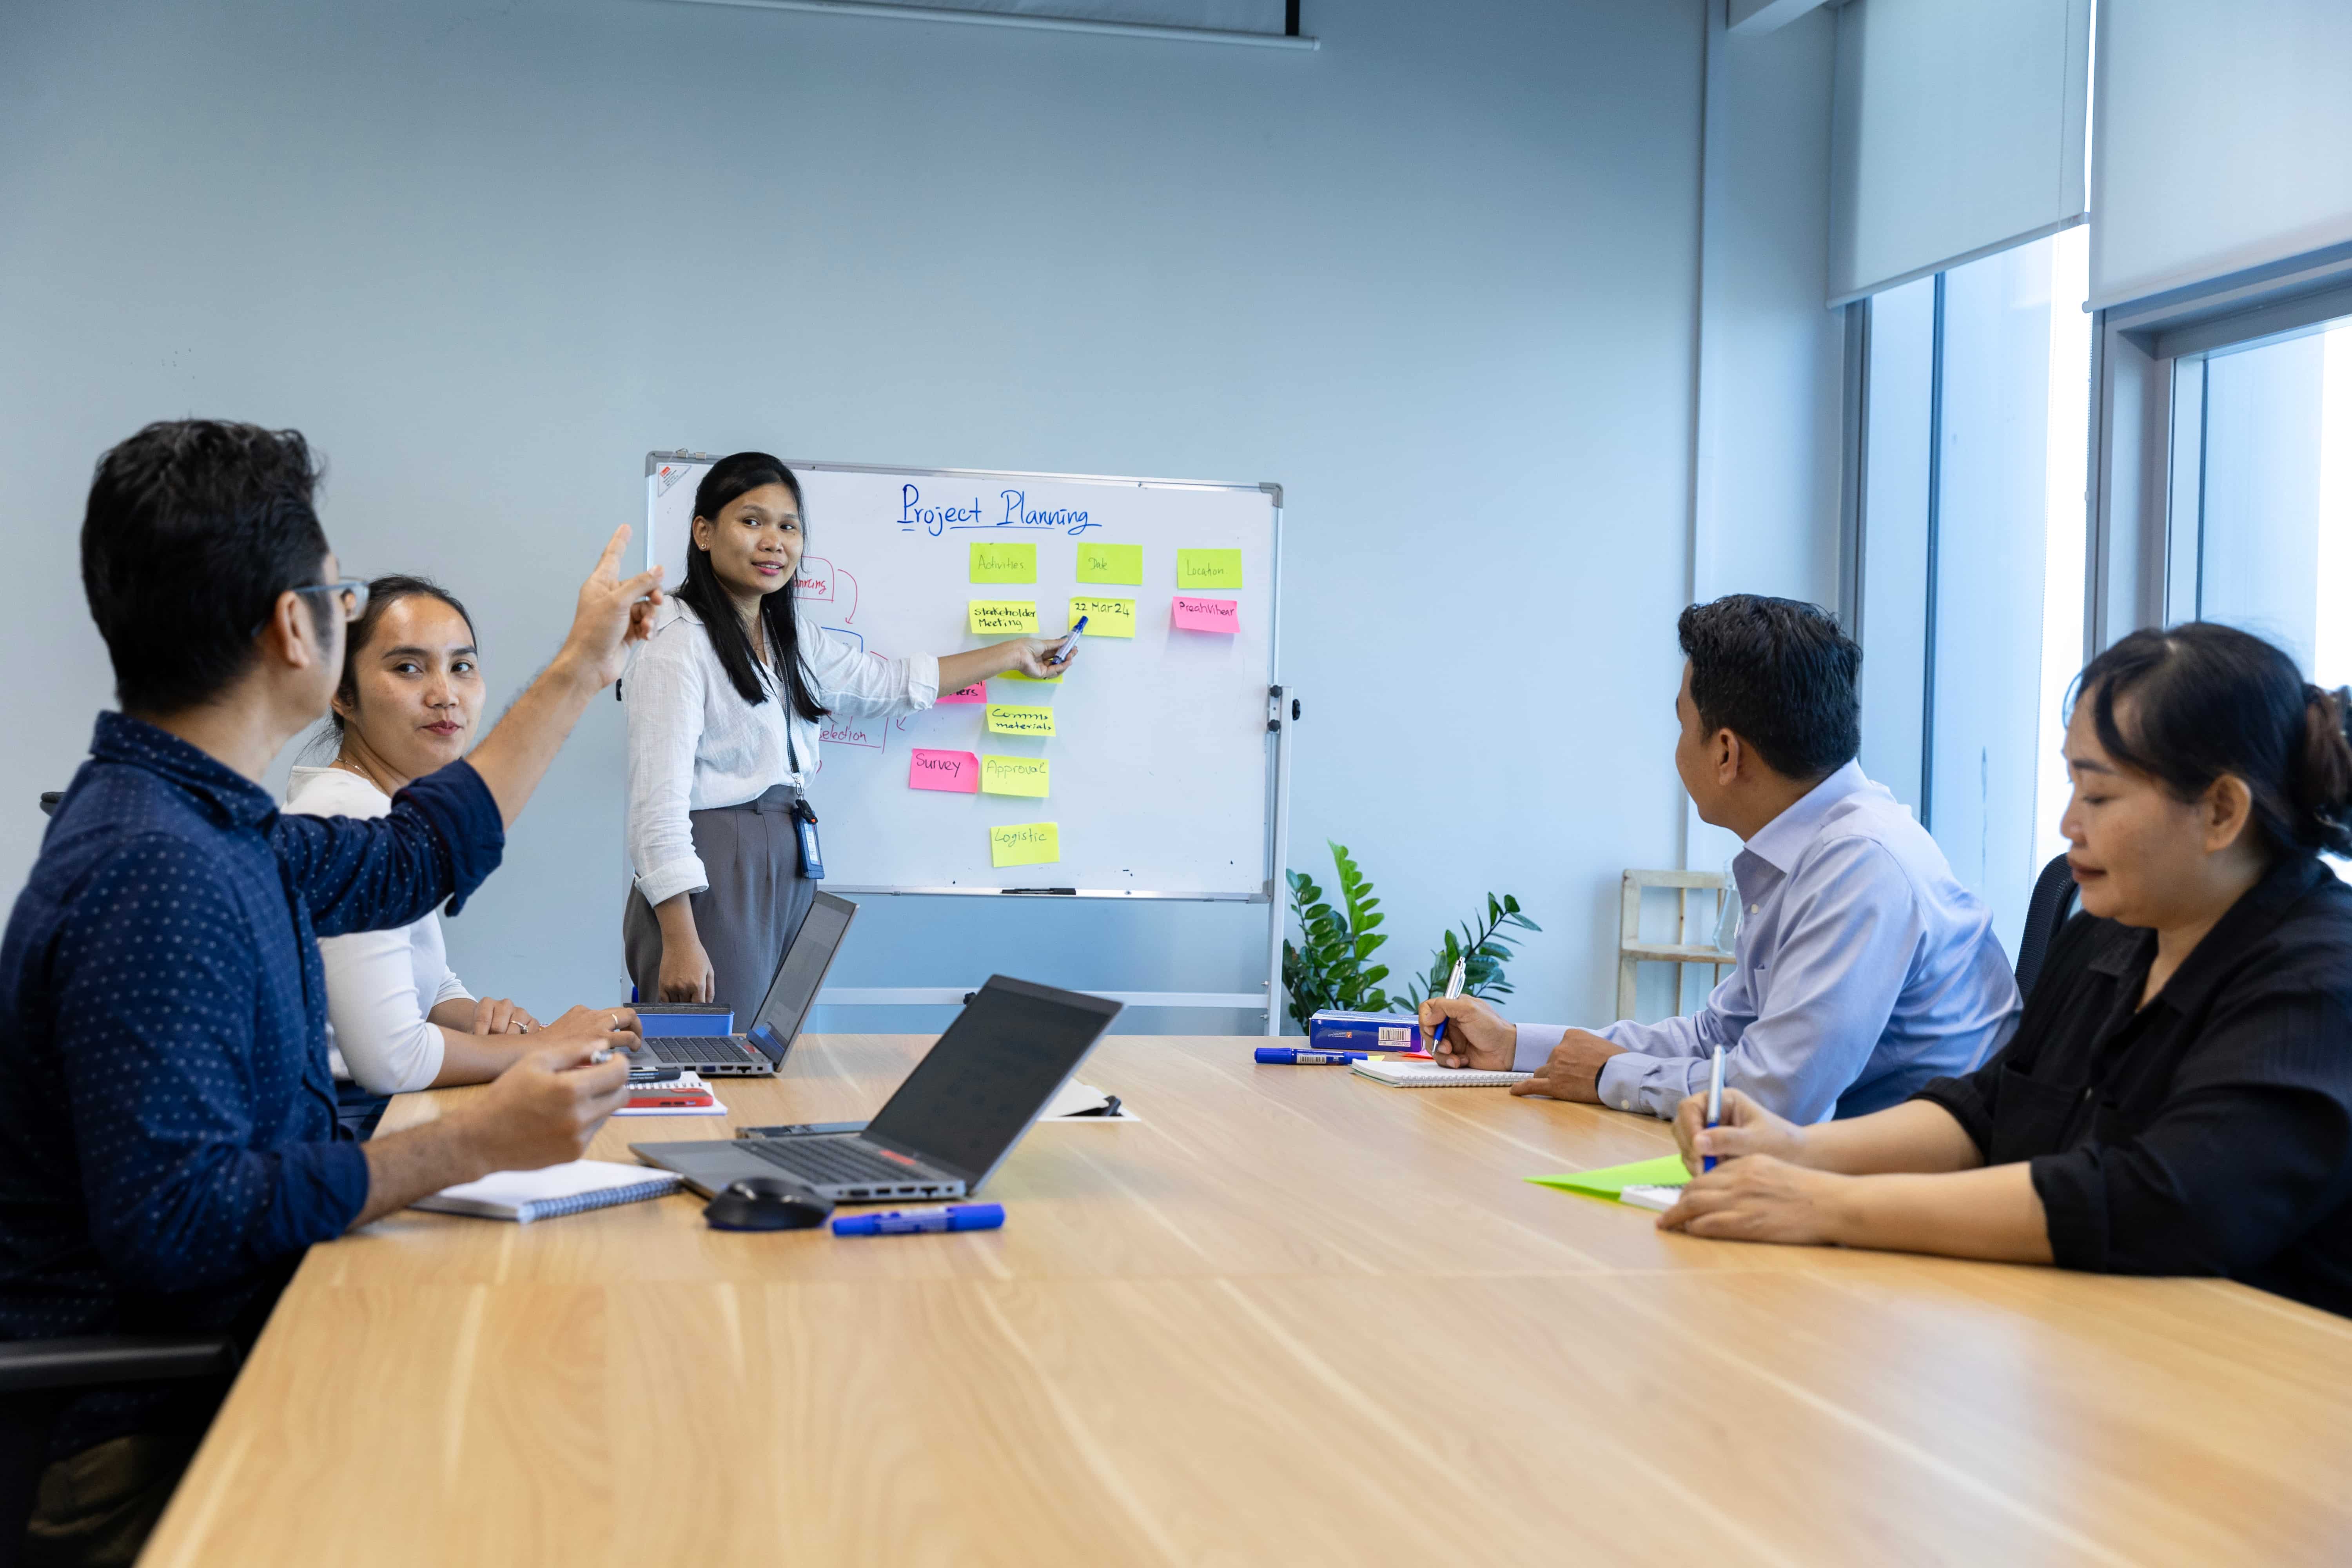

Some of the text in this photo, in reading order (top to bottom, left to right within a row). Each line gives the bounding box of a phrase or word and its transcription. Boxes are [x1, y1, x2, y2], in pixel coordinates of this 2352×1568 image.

[897, 484, 1102, 536] Project Planning
[1088, 557, 1108, 570] Date
[1092, 601, 1113, 612] Mar
[1114, 602, 1129, 618] 24
[979, 618, 1023, 631] Meeting
[916, 753, 960, 778] Survey
[986, 760, 1046, 779] Approval
[995, 828, 1047, 847] Logistic
